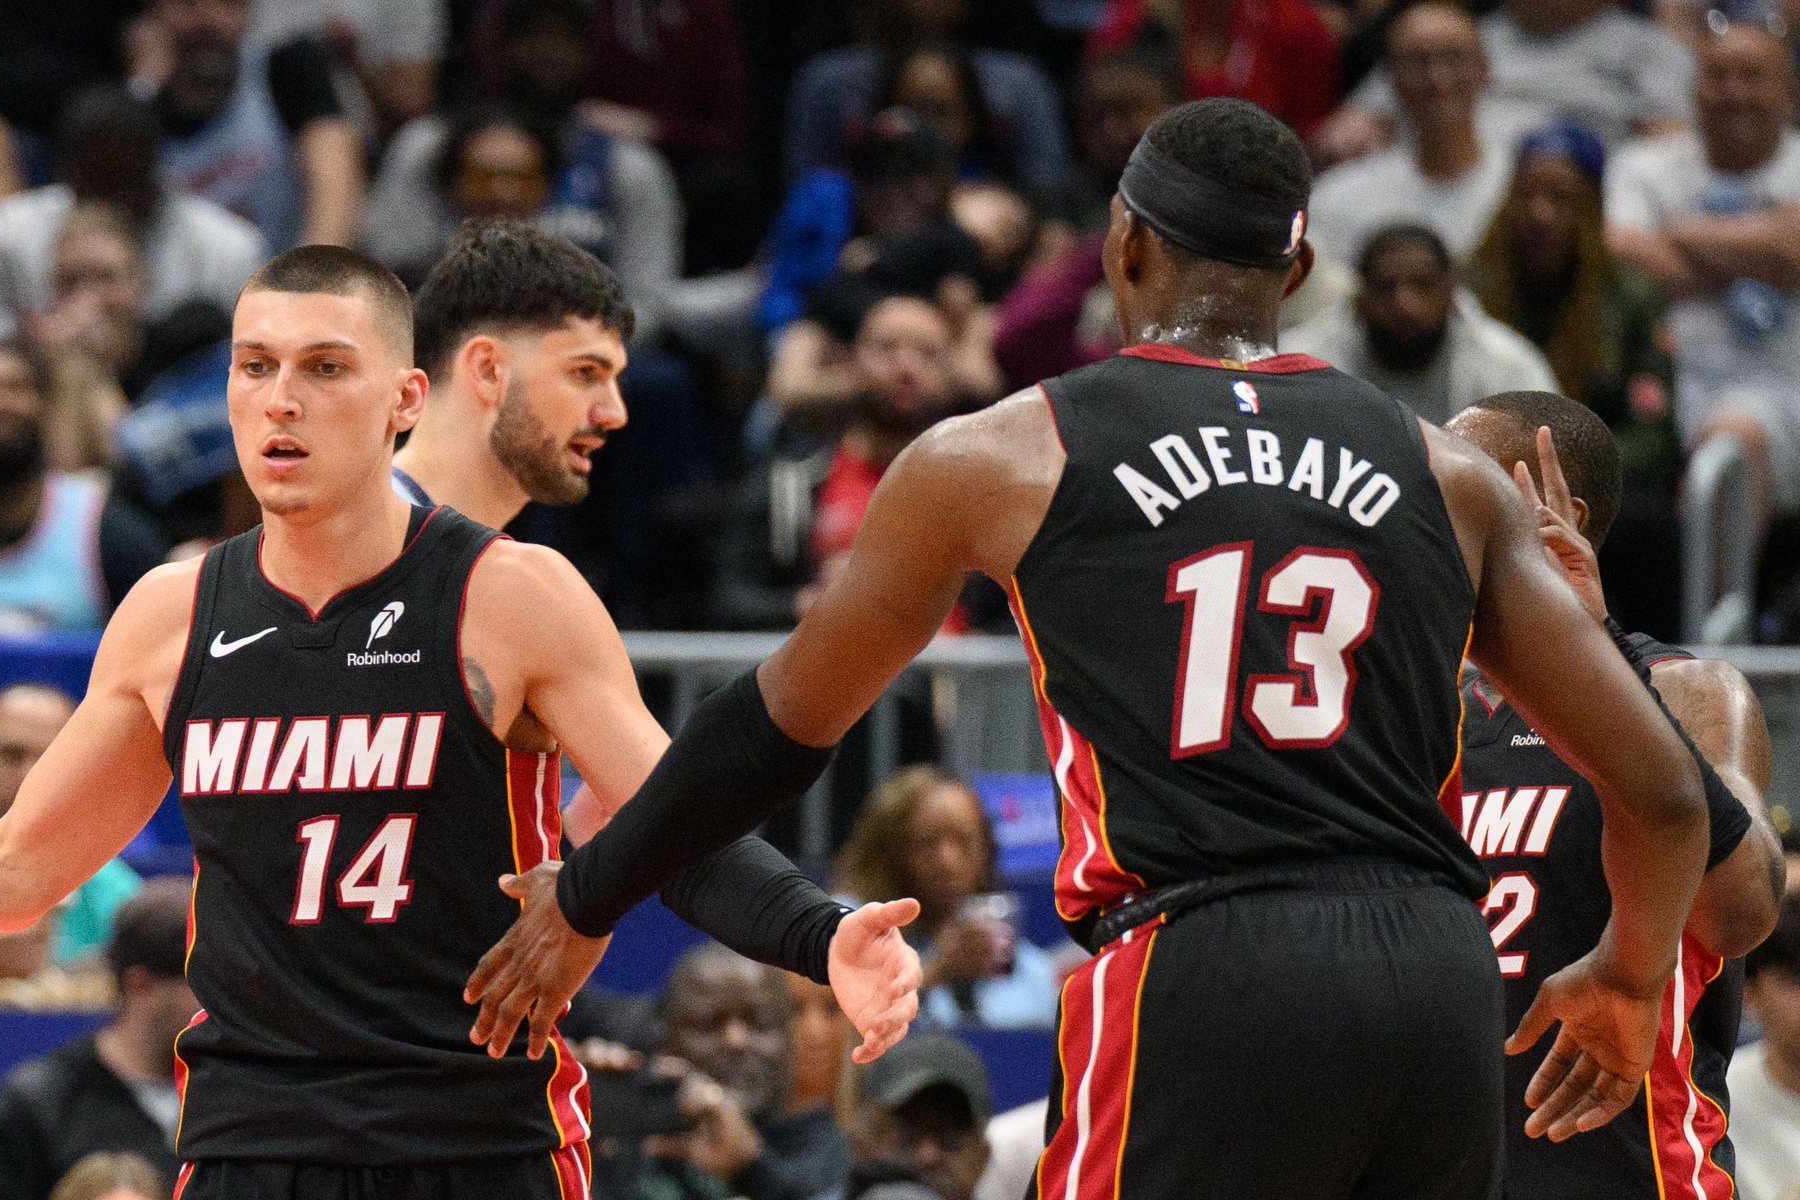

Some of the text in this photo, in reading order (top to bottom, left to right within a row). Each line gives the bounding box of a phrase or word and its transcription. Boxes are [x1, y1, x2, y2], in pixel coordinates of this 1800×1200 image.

[1112, 426, 1400, 528] ADEBAYO
[347, 649, 421, 667] Robinhood
[1164, 540, 1381, 760] 13
[180, 711, 446, 797] MIAMI
[1510, 733, 1546, 747] Robin
[288, 813, 418, 926] 14
